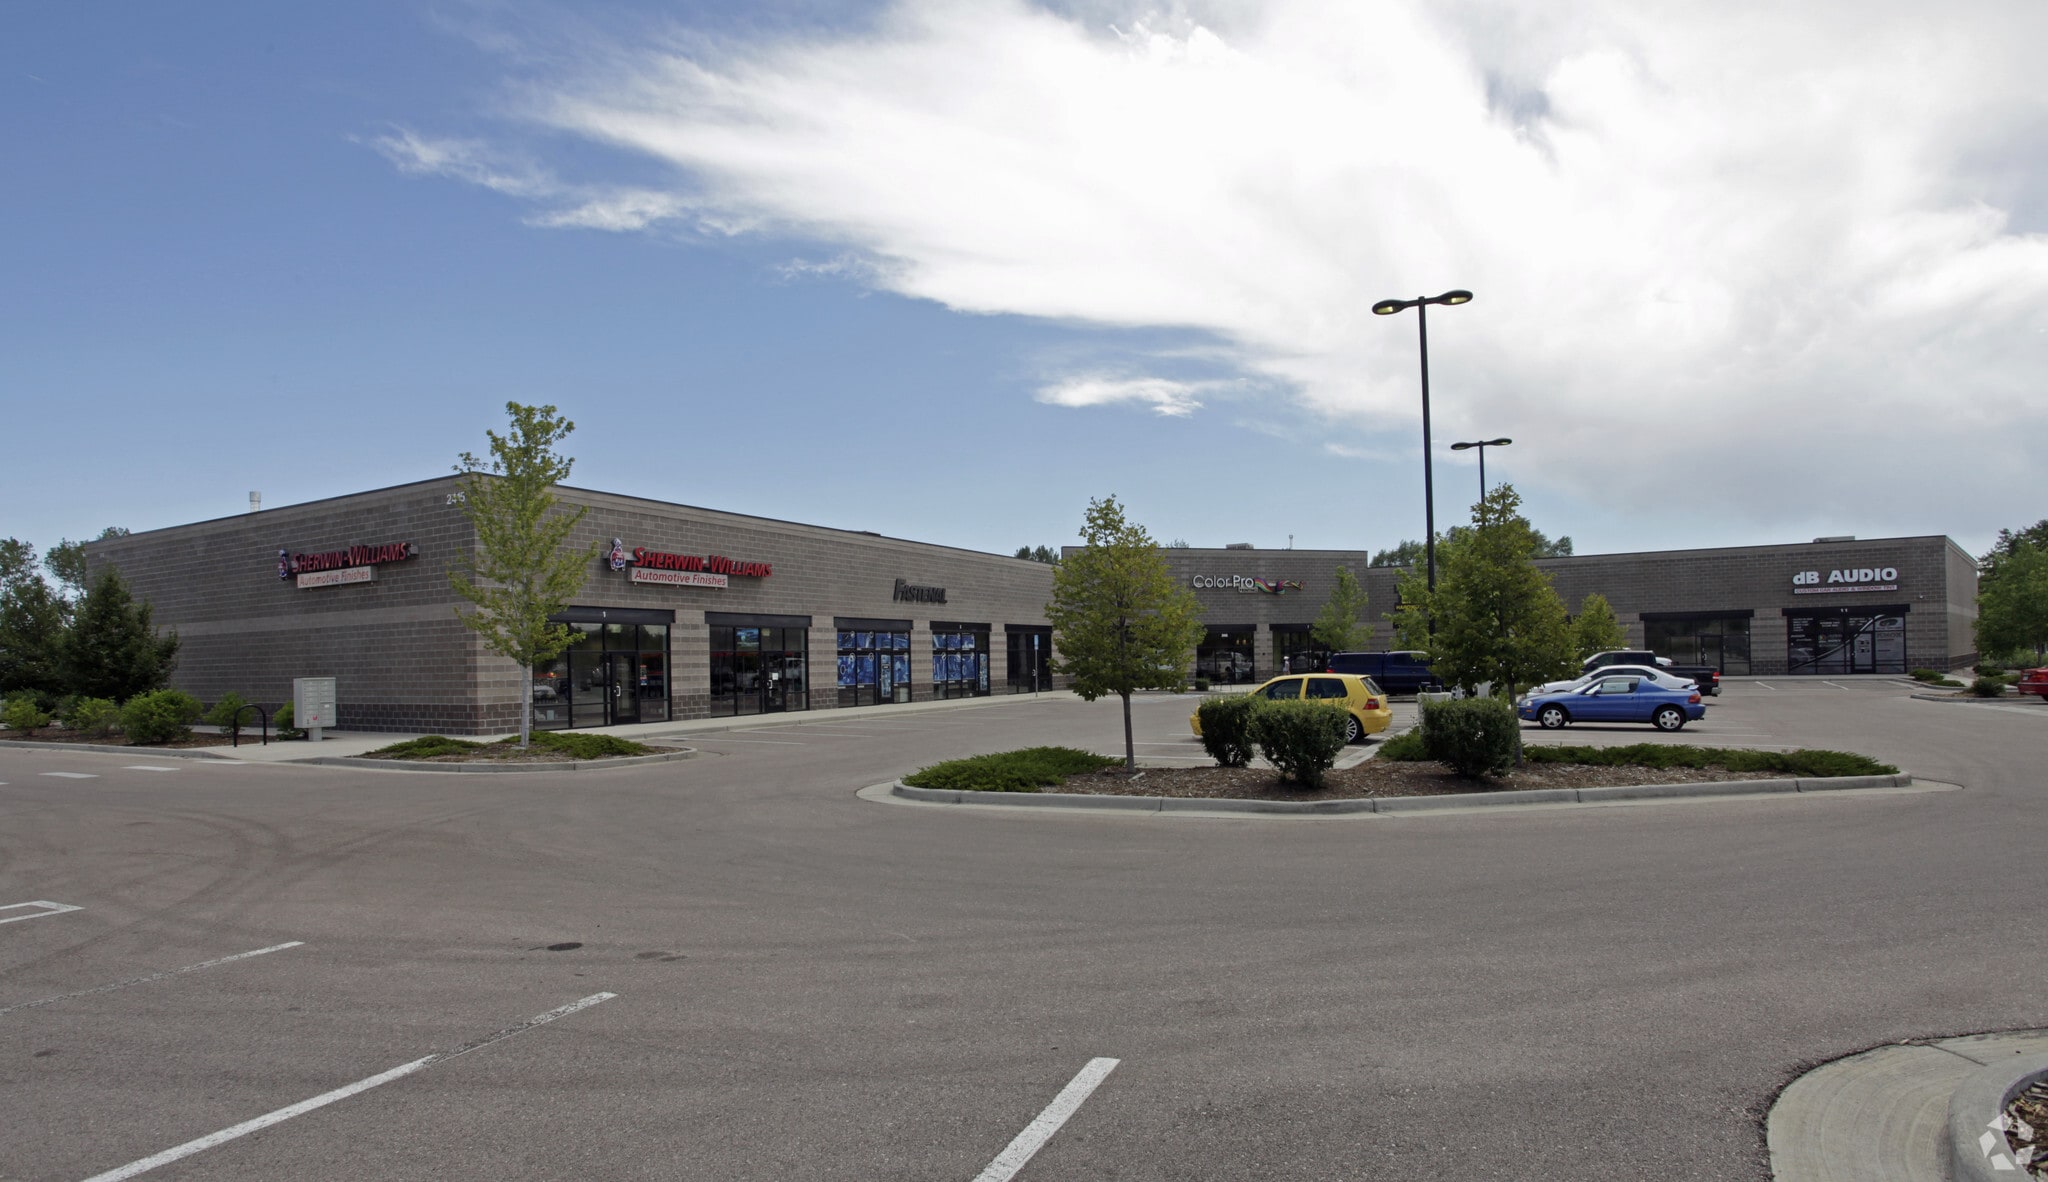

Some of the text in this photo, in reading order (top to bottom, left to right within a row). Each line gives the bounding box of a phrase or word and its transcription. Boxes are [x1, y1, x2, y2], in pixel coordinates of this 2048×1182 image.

[633, 546, 773, 578] SHERWIN-WILLIAMS
[299, 569, 369, 587] Automotive Finishes
[634, 569, 726, 586] Automotive Finishes
[1792, 567, 1898, 585] dB AUDIO
